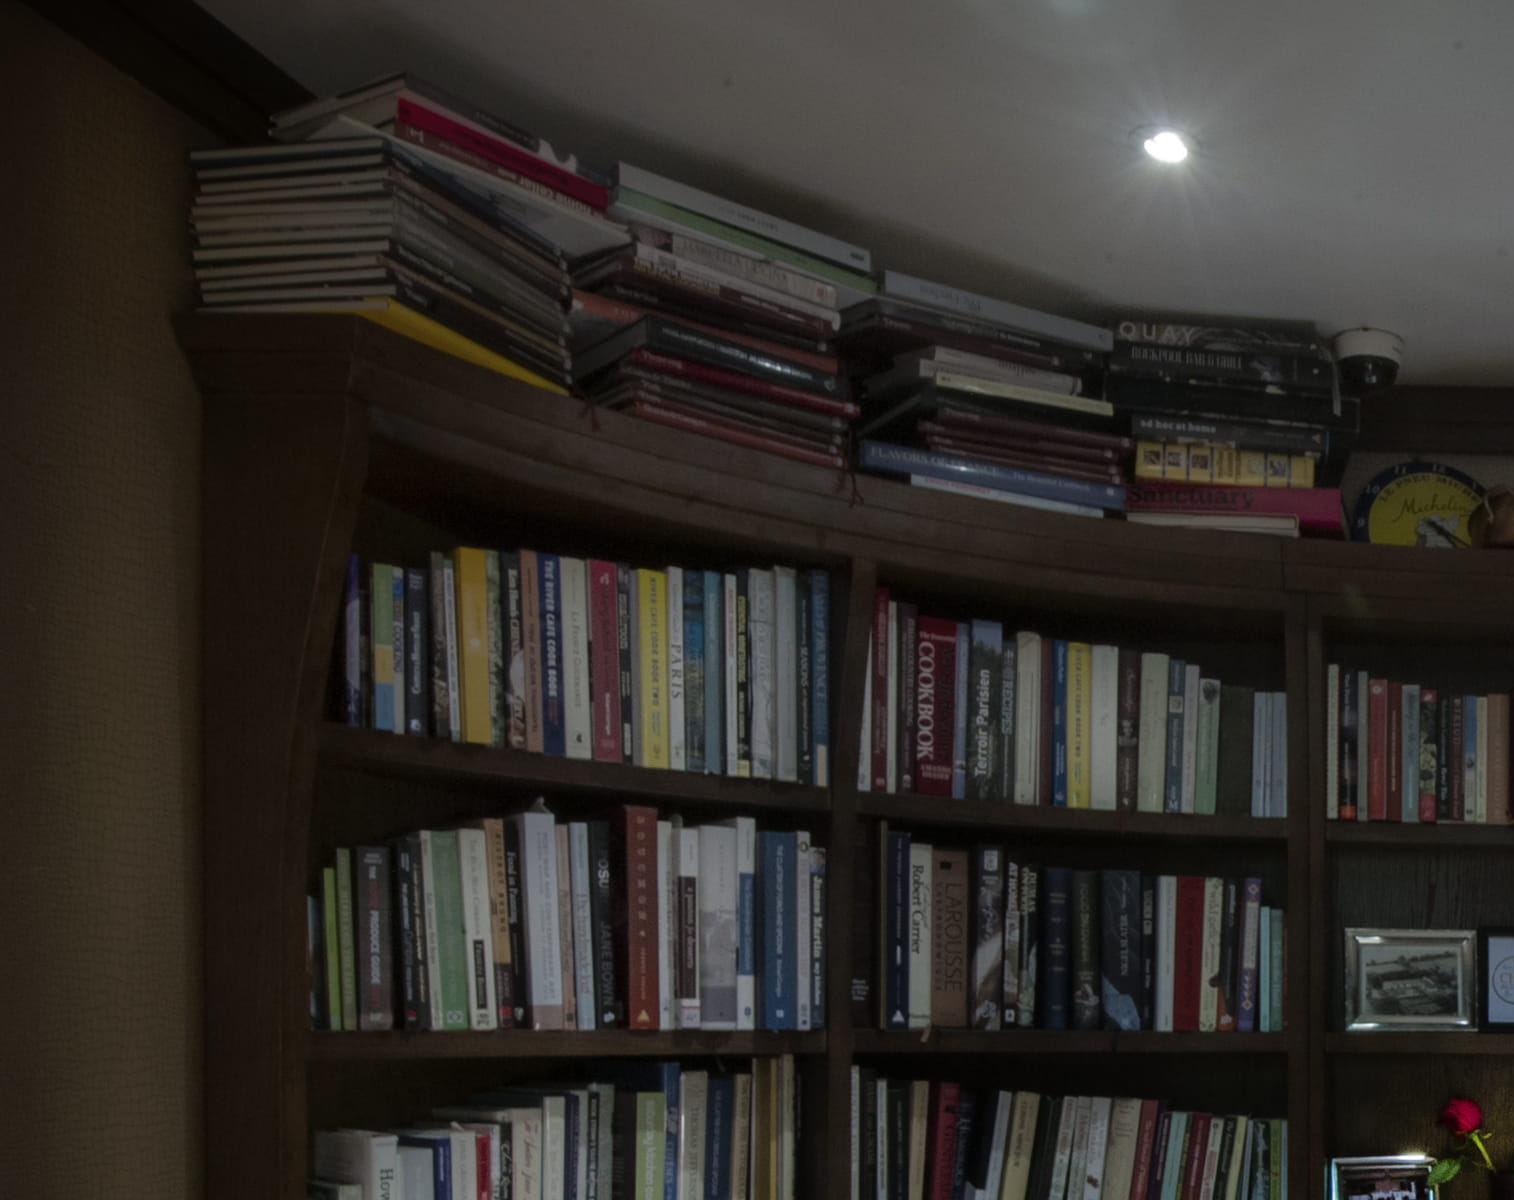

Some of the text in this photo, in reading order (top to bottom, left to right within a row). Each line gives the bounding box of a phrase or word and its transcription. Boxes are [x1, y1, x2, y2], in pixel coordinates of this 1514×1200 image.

[1119, 321, 1194, 345] QUAY
[1127, 486, 1255, 509] Sanctuary
[1391, 494, 1471, 522] Michelin
[545, 560, 557, 698] THE RIVER CAFE COOK BOOK
[650, 607, 658, 628] CAFE
[671, 643, 682, 700] PARIS
[652, 686, 660, 707] TWO
[917, 641, 936, 761] COOKBOOK
[1002, 680, 1013, 736] RECIPES
[974, 669, 990, 777] Terroir Parisien
[812, 875, 824, 914] James
[911, 864, 925, 955] Robert Carrier
[599, 921, 613, 959] JANE
[812, 915, 824, 959] Martin
[945, 881, 963, 993] LAROUSSE
[600, 960, 615, 1006] BOWN
